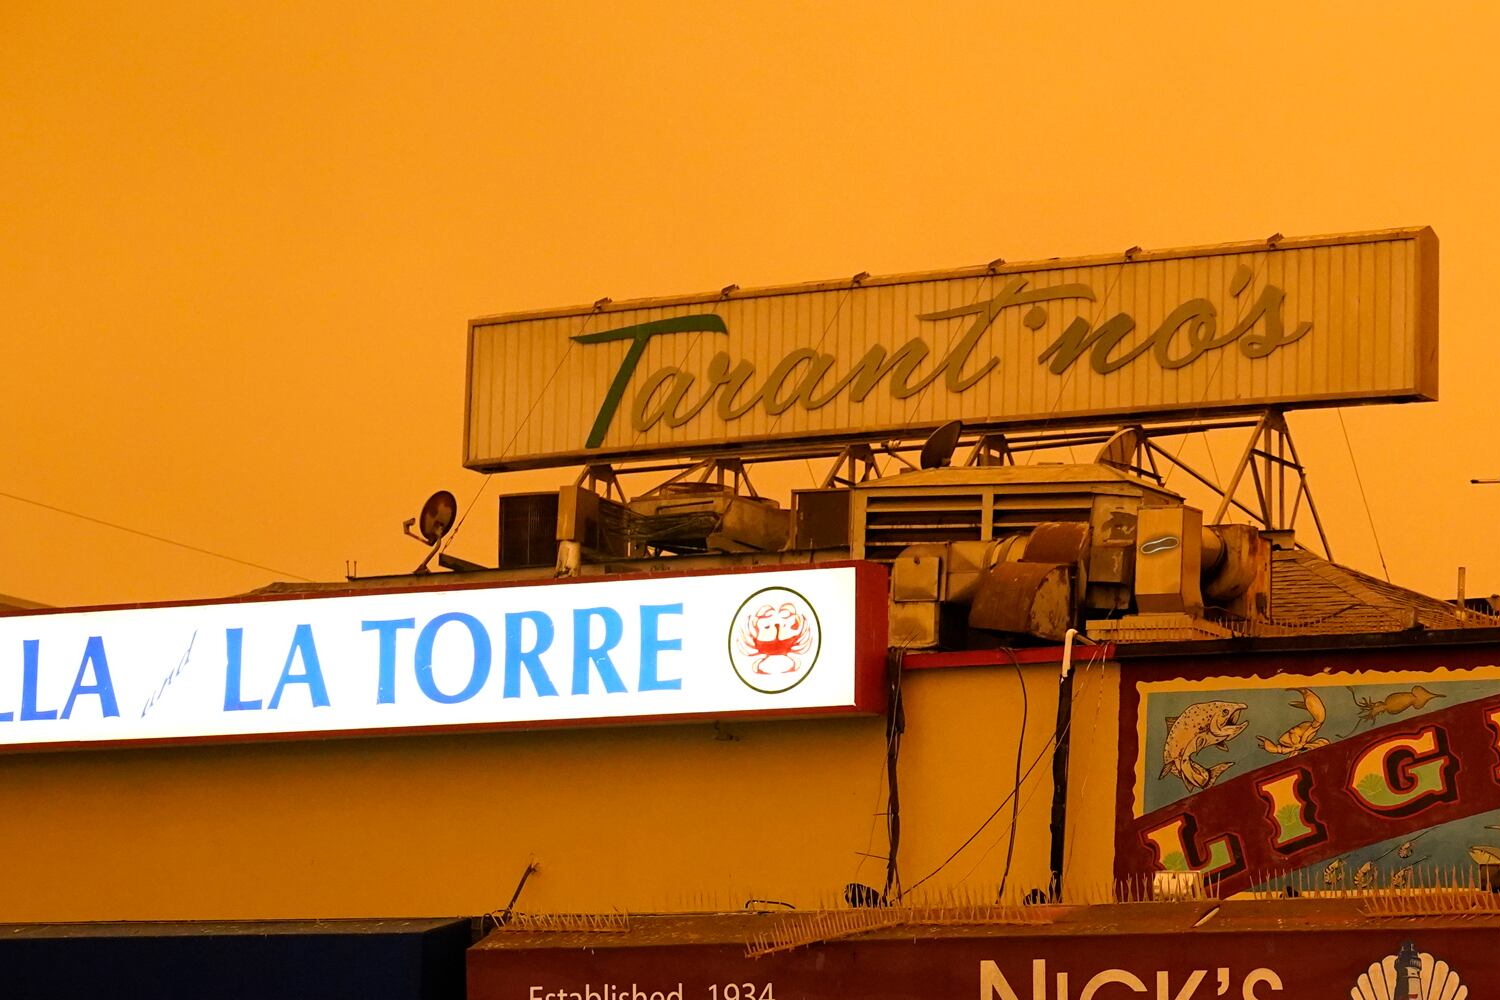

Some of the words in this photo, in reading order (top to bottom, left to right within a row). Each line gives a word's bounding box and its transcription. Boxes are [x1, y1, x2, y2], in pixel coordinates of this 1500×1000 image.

[569, 264, 1313, 449] Tarantno's
[0, 636, 120, 722] LA
[223, 624, 331, 711] LA
[361, 603, 684, 705] TORRE
